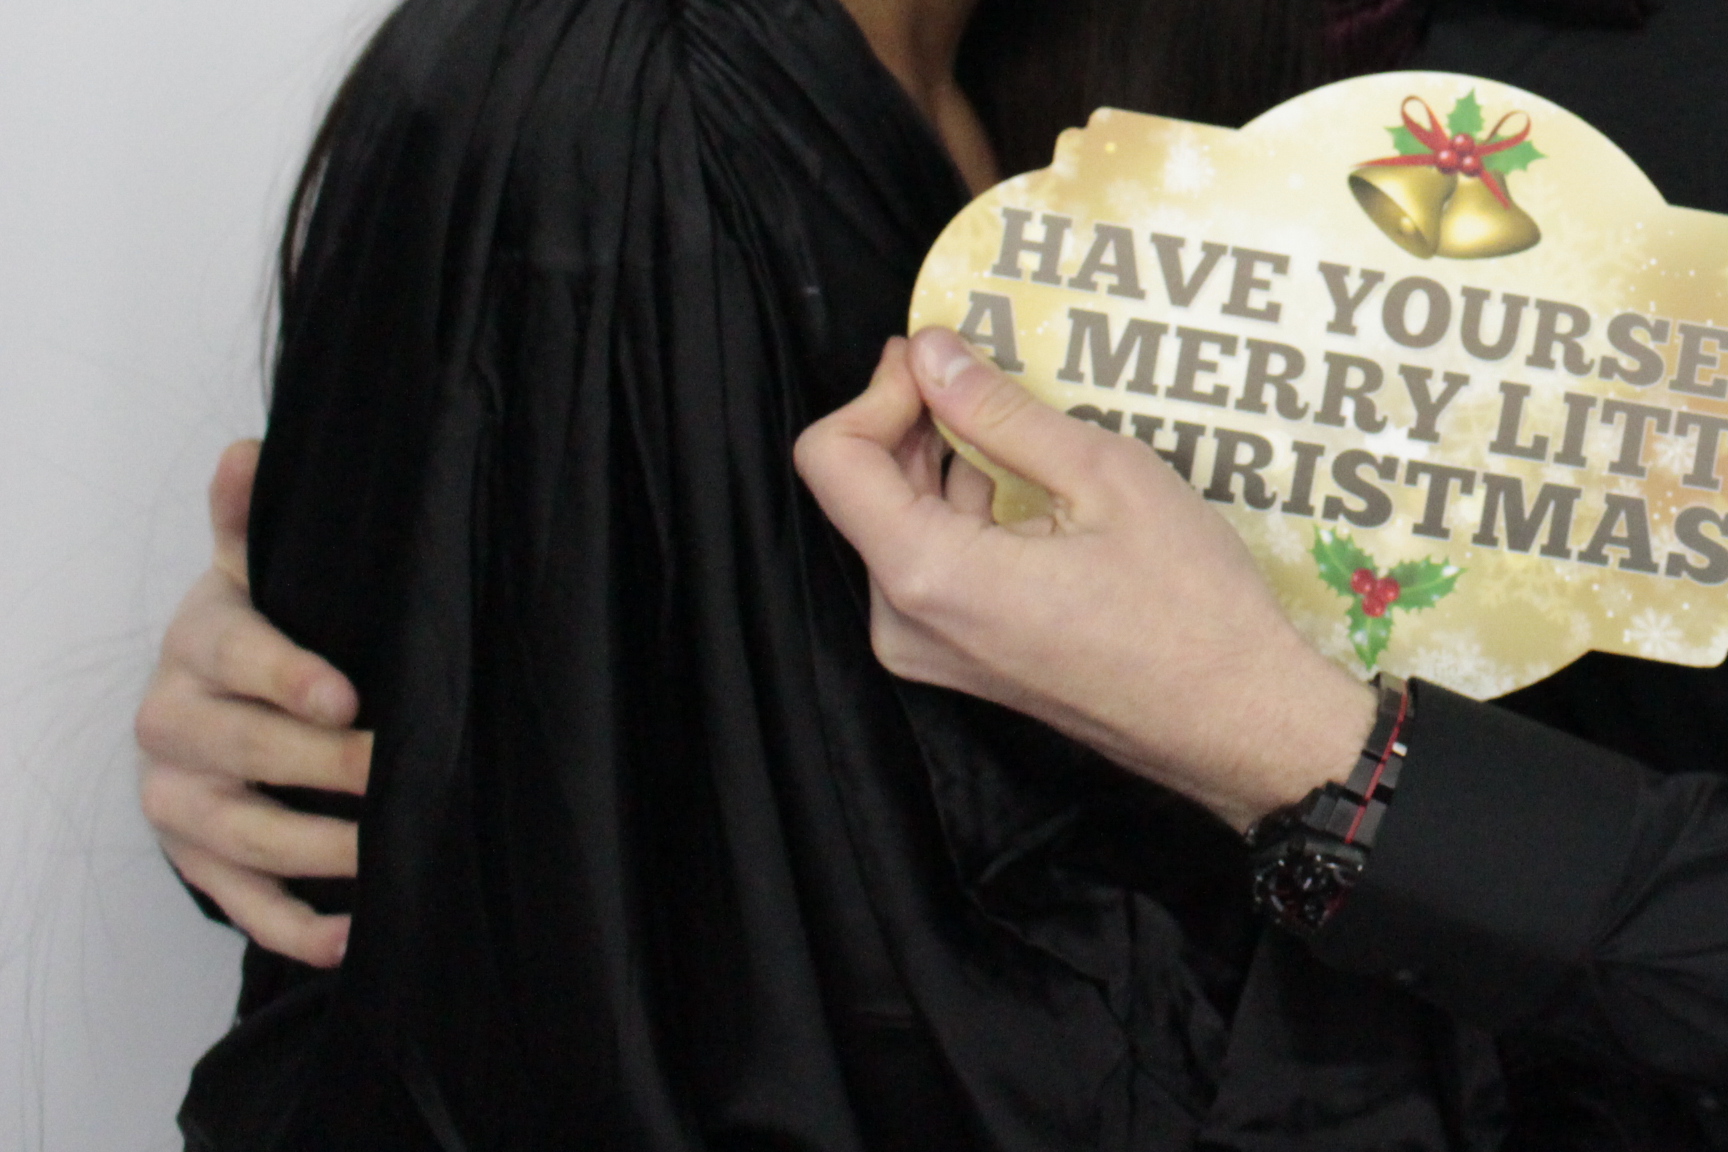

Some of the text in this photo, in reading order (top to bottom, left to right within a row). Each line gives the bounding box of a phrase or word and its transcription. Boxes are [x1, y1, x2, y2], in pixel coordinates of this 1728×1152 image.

[991, 208, 1290, 324] HAVE
[957, 291, 1025, 374] A
[1056, 308, 1470, 442] MERRY
